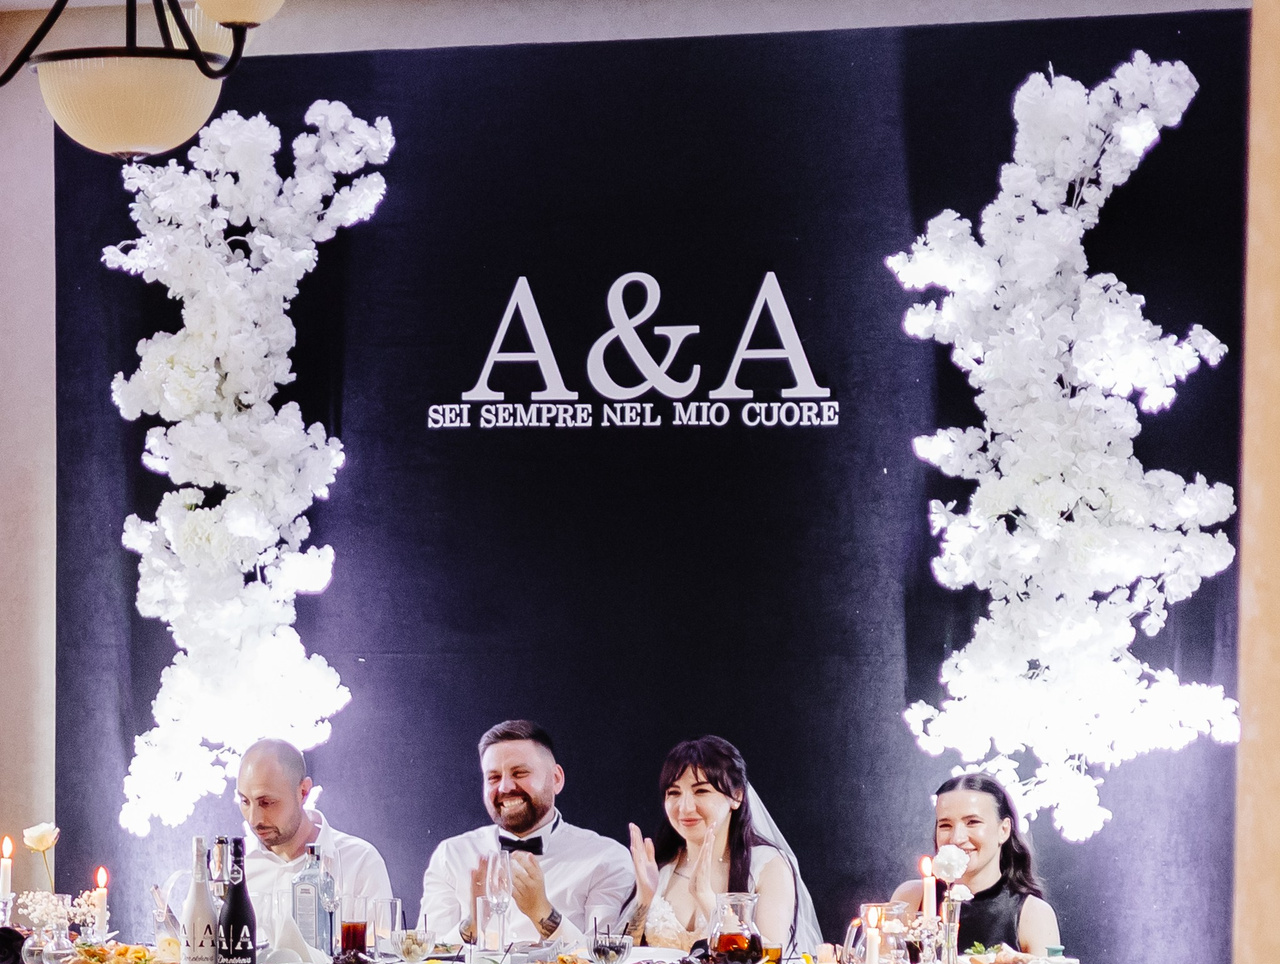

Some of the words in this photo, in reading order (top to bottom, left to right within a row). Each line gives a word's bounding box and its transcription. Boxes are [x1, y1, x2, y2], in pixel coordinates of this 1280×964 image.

[461, 271, 831, 401] A&A
[427, 404, 472, 429] SEI
[479, 403, 593, 429] SEMPRE
[600, 402, 662, 427] NEL
[672, 401, 731, 427] MIO
[741, 401, 840, 427] CUORE
